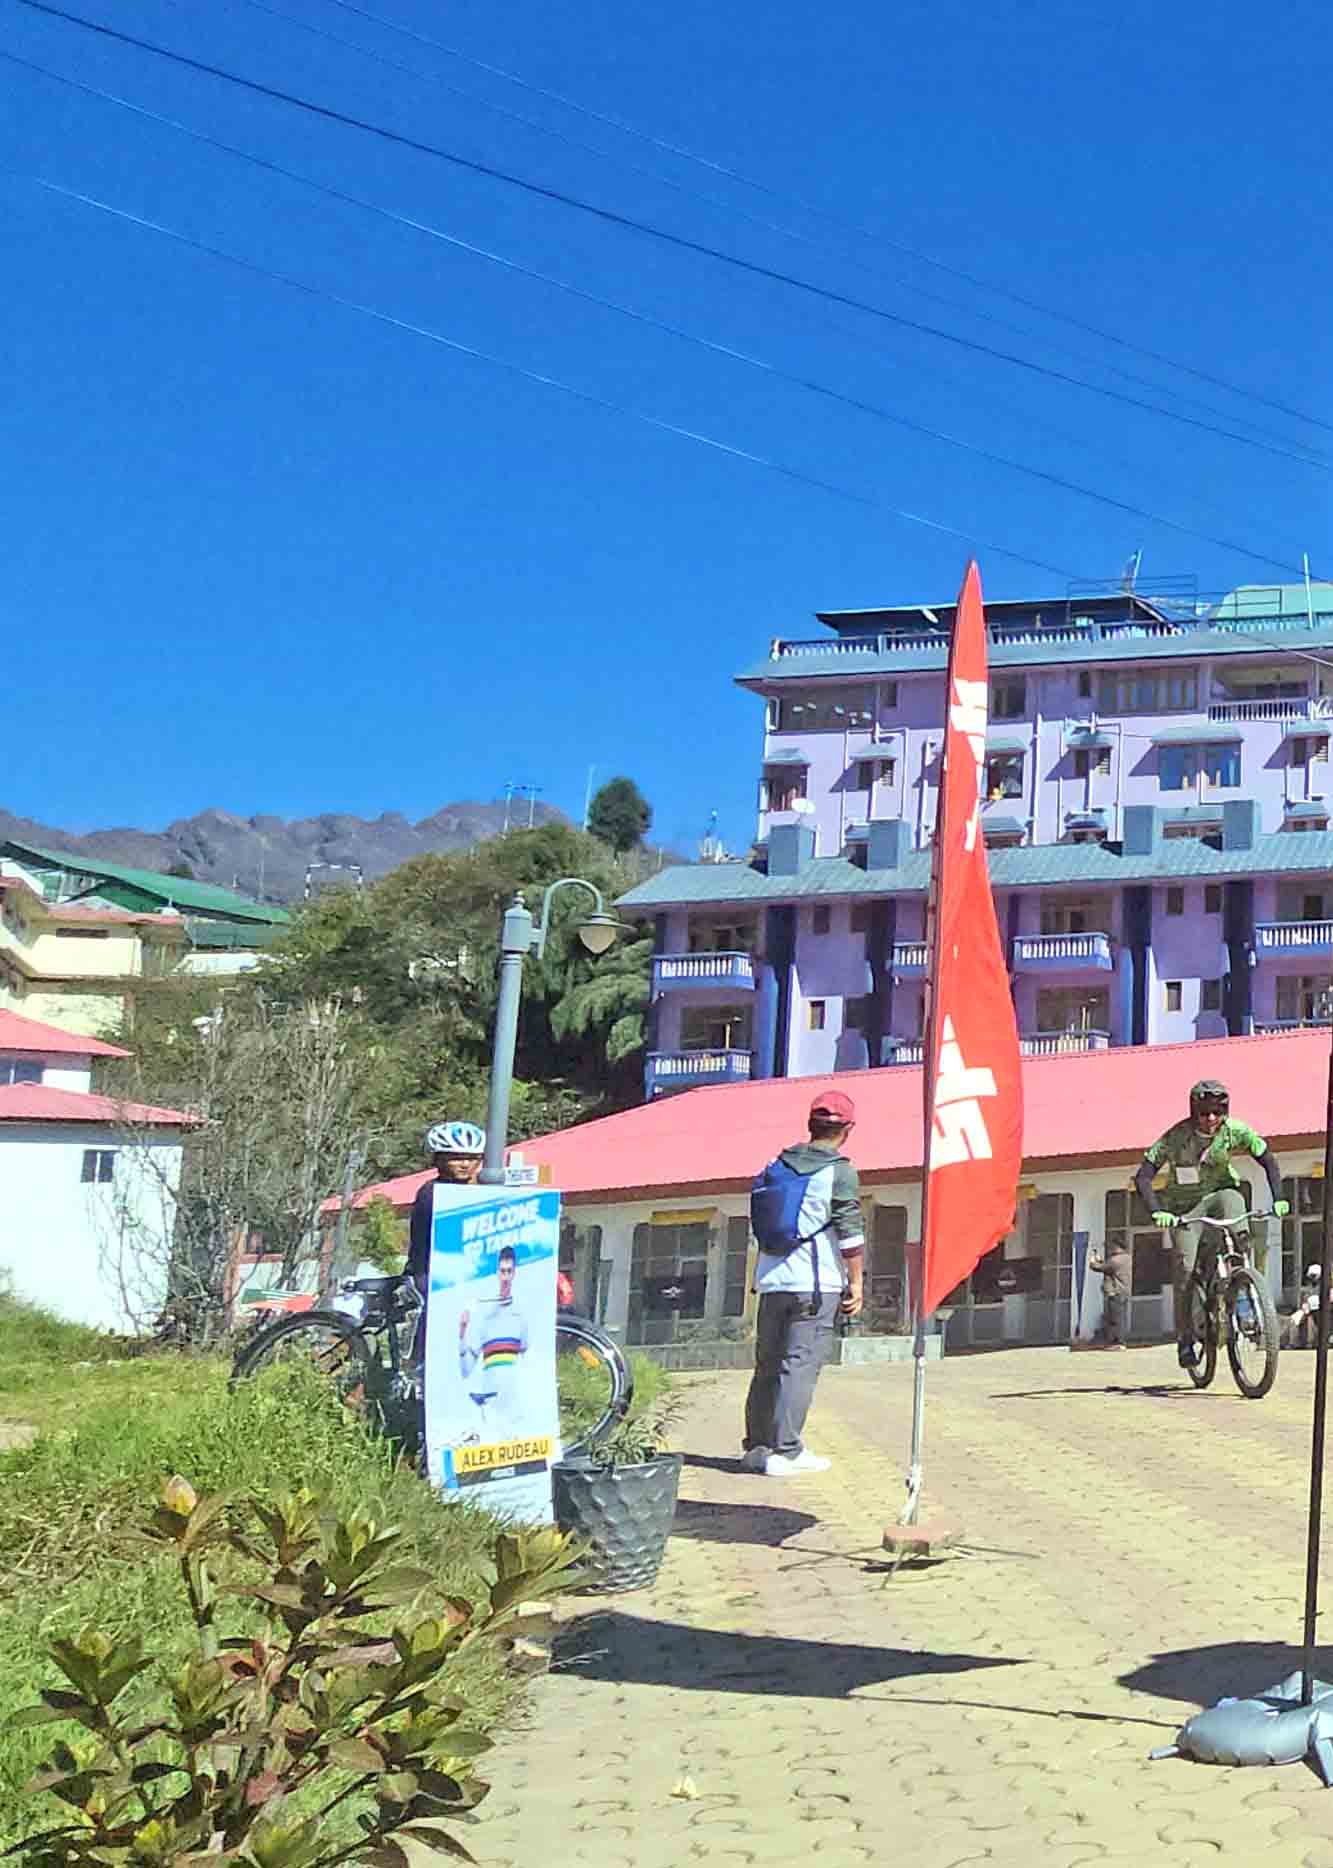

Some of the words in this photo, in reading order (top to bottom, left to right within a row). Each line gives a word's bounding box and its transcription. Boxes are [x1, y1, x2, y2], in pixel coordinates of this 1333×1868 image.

[462, 1200, 540, 1242] WELCOME
[462, 1447, 496, 1470] ALEX
[498, 1439, 549, 1463] RUDEAU
